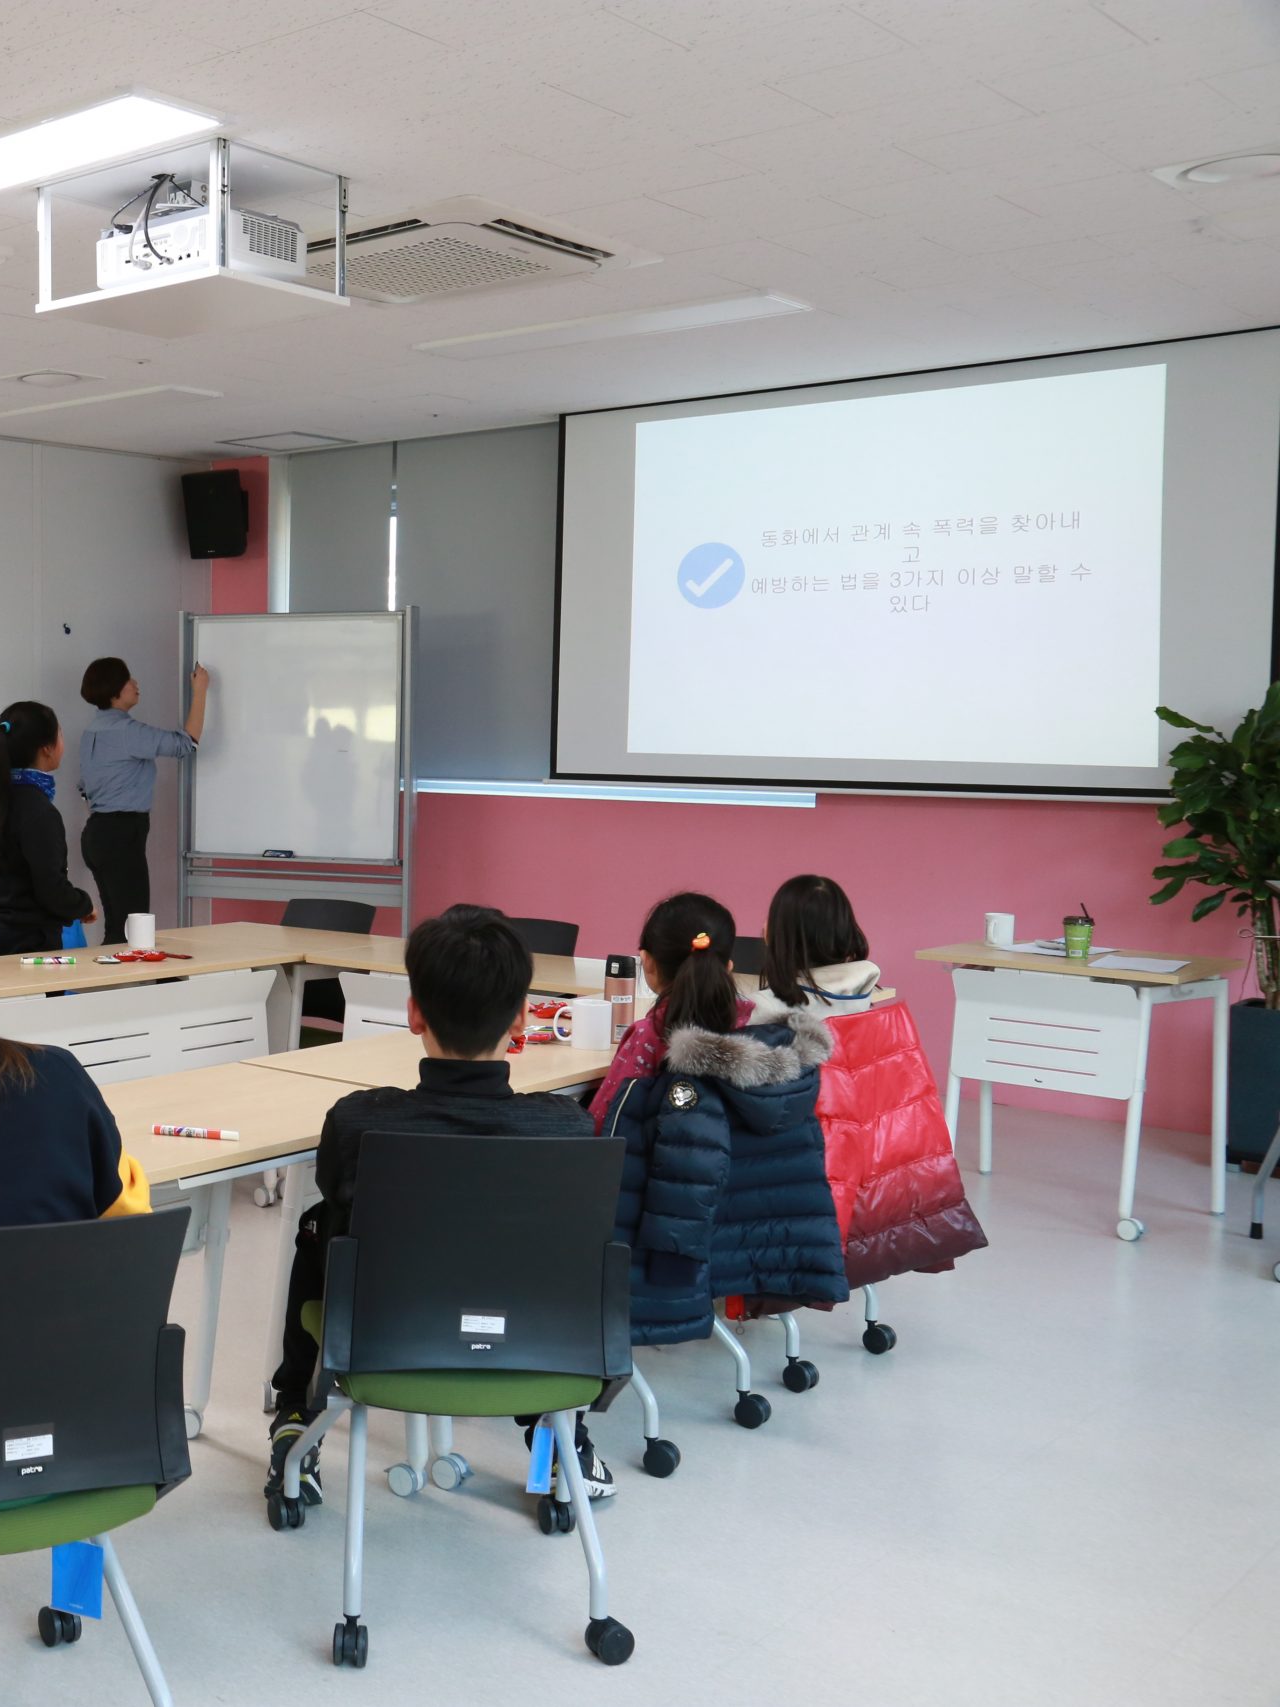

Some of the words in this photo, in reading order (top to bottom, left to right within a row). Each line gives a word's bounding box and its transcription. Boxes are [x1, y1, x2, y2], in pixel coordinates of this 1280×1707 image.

[761, 526, 840, 549] 동화에서
[851, 521, 892, 543] 관계
[902, 521, 921, 541] 속
[933, 514, 999, 537] 폭력을
[1011, 510, 1082, 533] 찾아내
[901, 547, 921, 563] 고
[751, 573, 830, 595] 예방하는
[840, 570, 880, 592] 법을
[889, 569, 945, 591] 3가지
[957, 565, 1001, 586] 이상
[1013, 563, 1058, 585] 말할
[1070, 561, 1093, 582] 수
[889, 593, 932, 615] 있다
